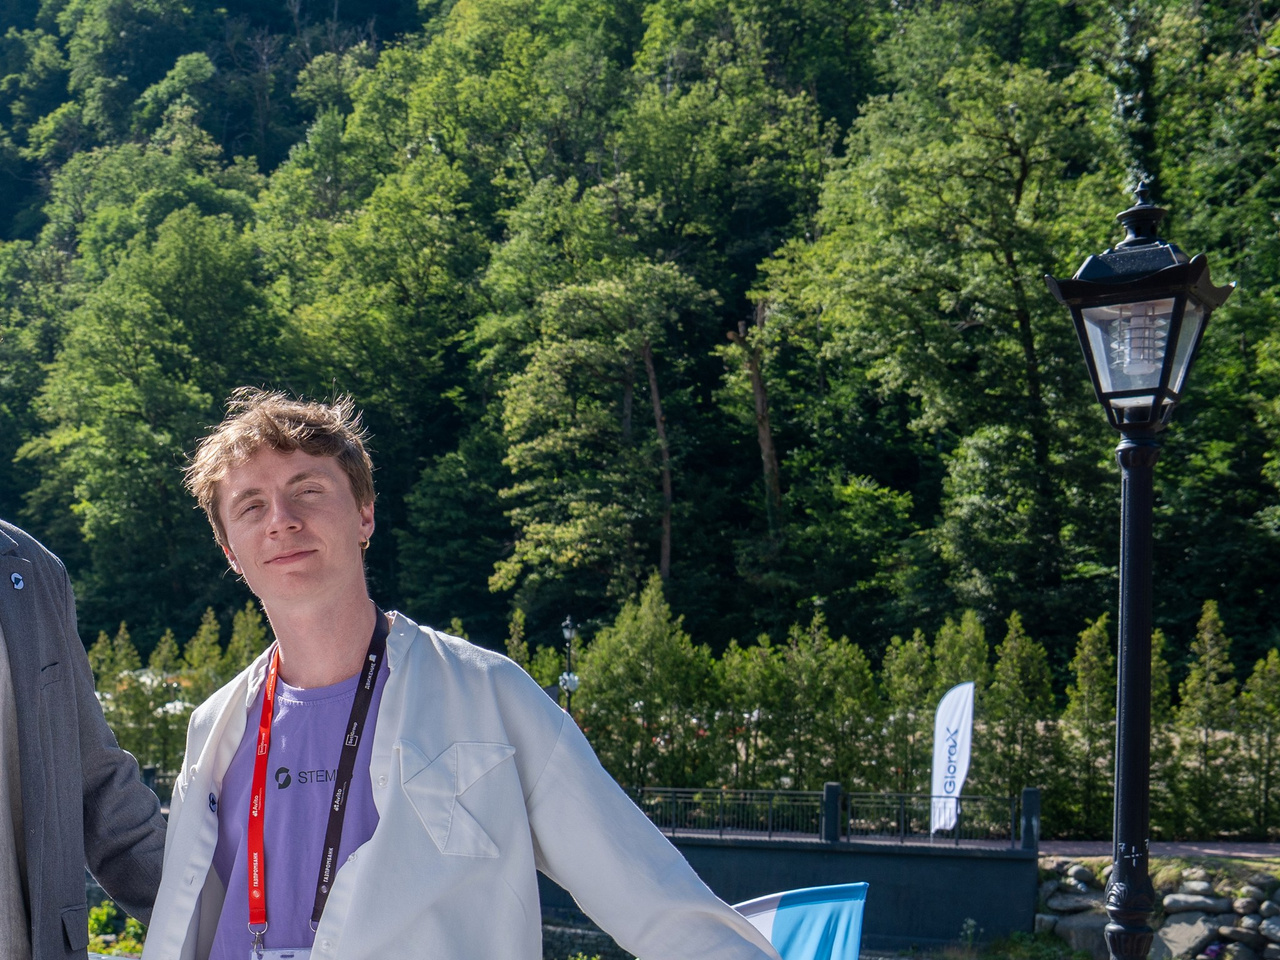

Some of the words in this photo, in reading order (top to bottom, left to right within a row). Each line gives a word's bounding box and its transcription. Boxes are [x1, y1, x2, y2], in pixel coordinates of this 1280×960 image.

[364, 663, 376, 690] ДВИЖЕНИЕ
[944, 727, 958, 794] GloraX
[298, 769, 353, 784] STEM
[323, 847, 334, 883] ГАЗПРОМБАНК
